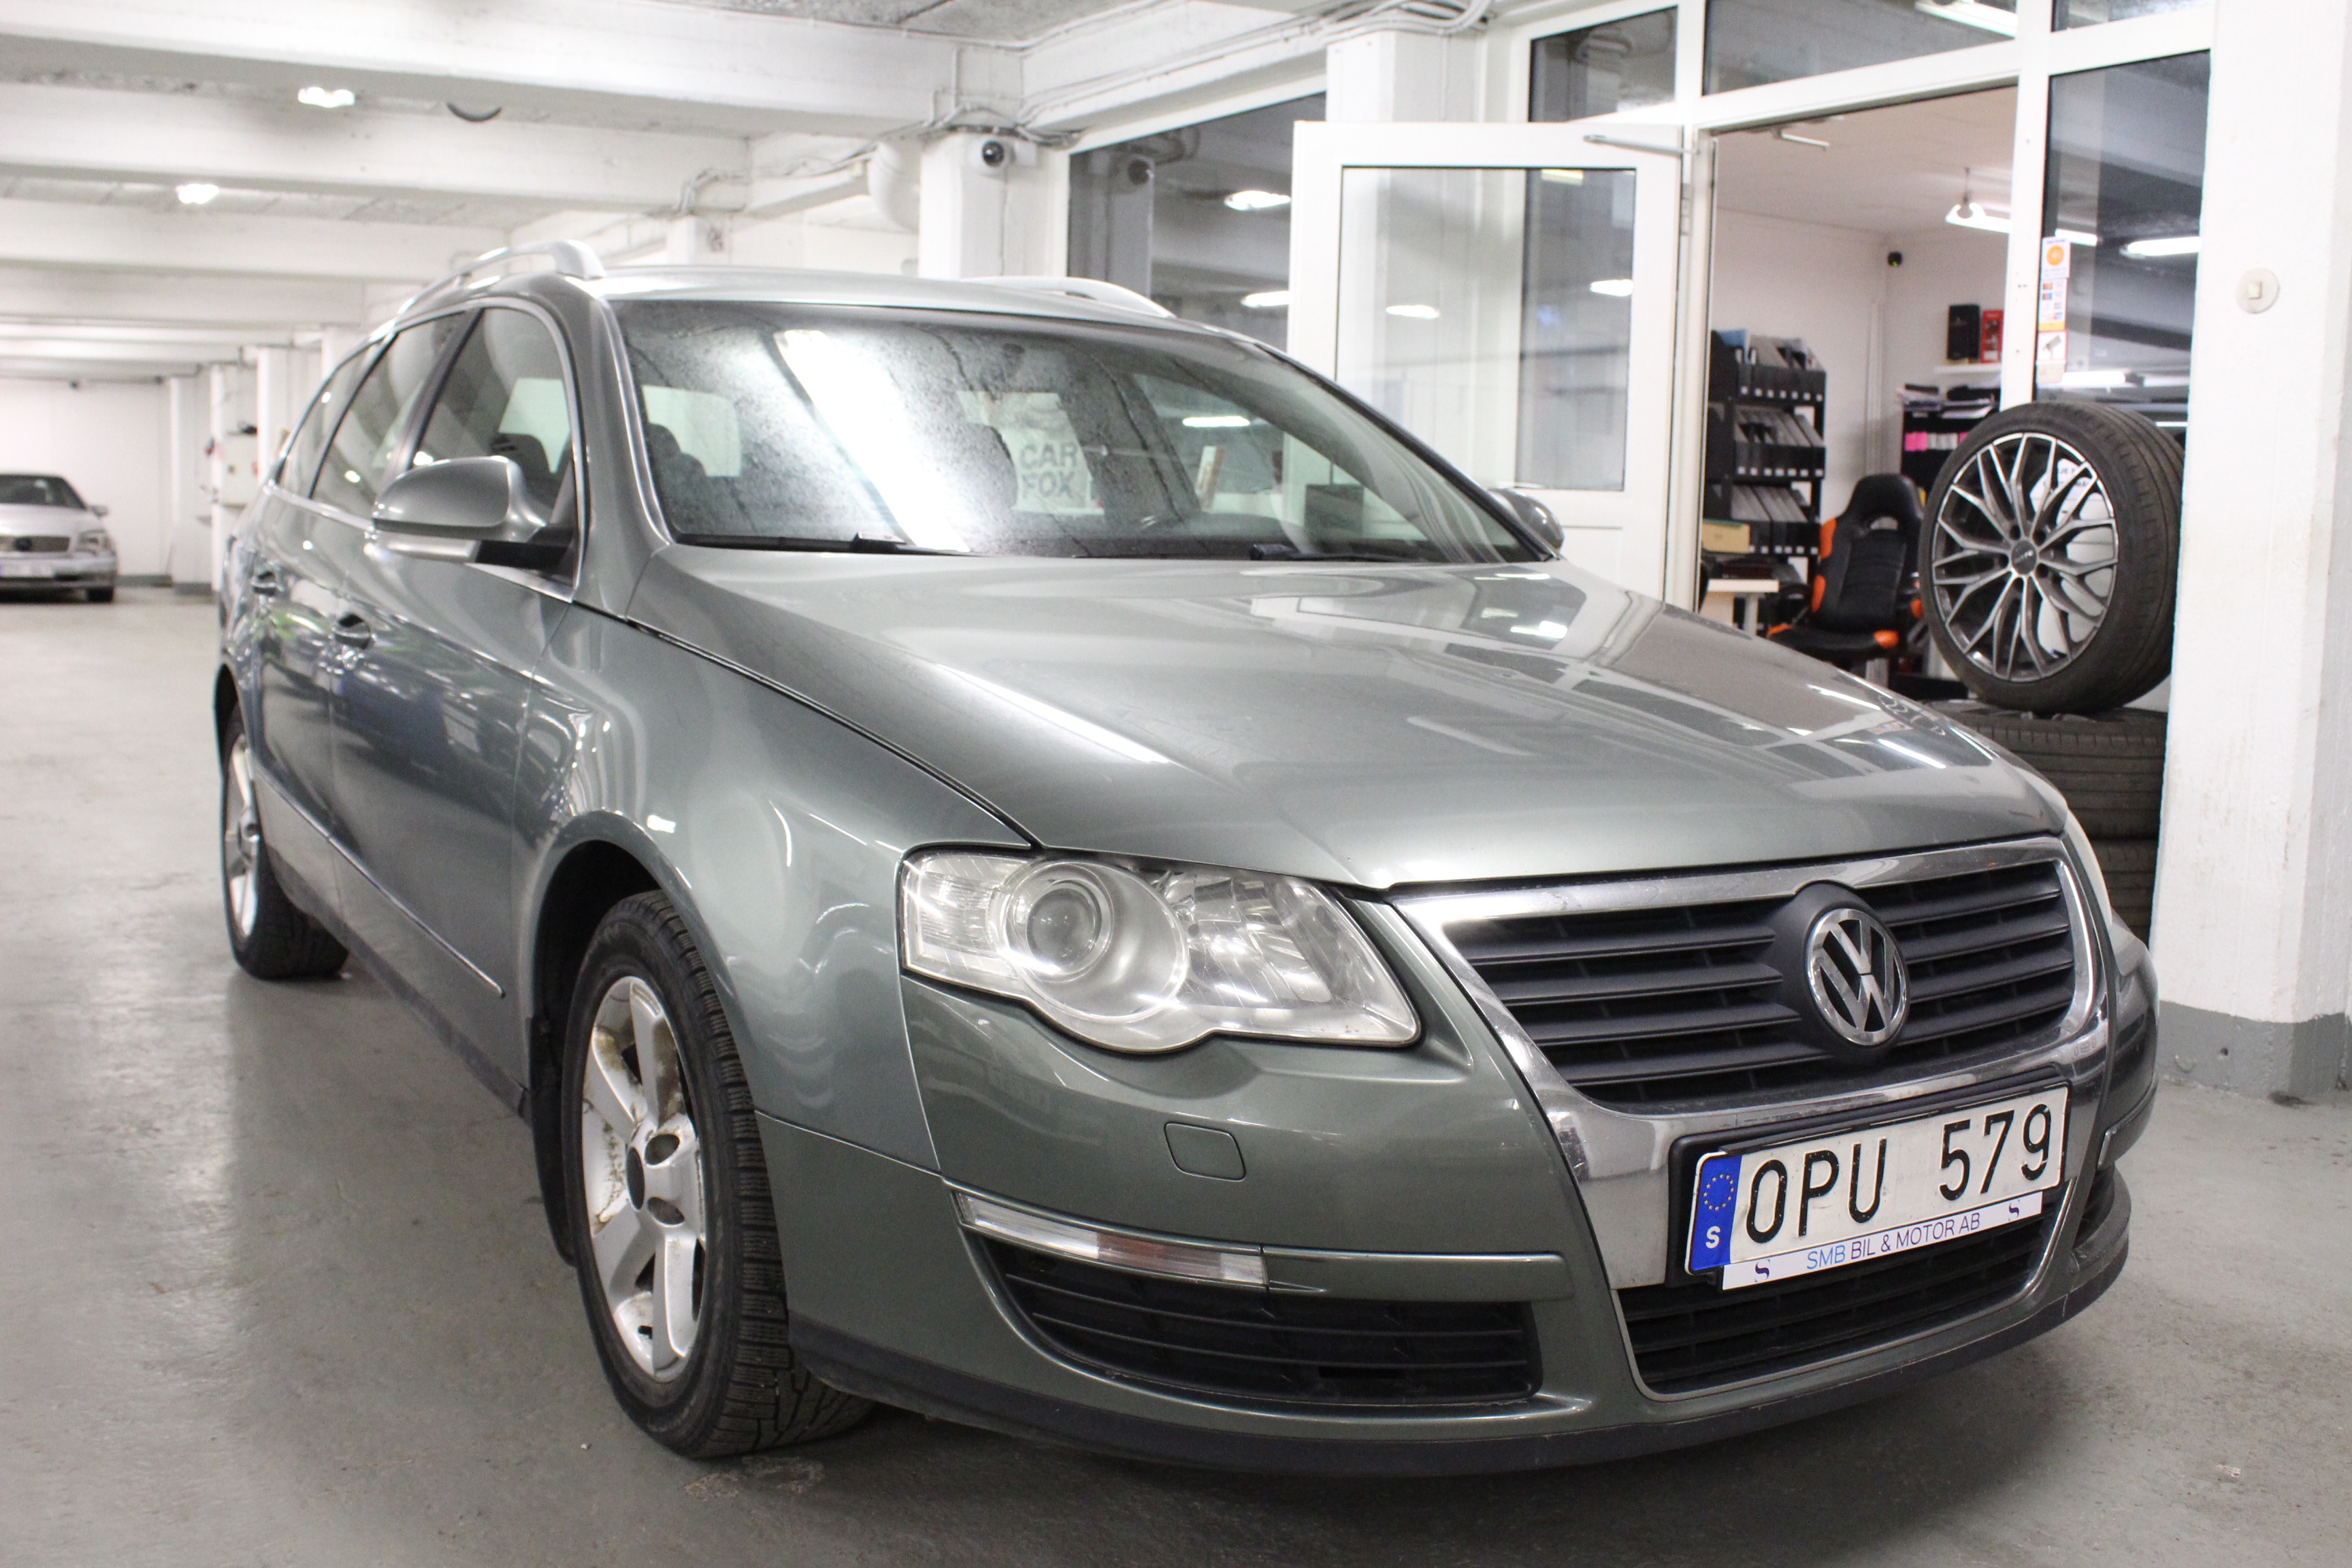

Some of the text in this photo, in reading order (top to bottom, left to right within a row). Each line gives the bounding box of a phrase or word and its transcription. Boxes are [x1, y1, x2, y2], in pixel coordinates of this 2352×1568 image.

[1019, 441, 1078, 469] CAR
[1022, 471, 1075, 499] FOX
[1807, 908, 1907, 1045] VW
[1746, 1103, 2052, 1244] OPU 579
[1705, 1225, 1720, 1249] S
[1806, 1212, 1980, 1270] SMB BIL & MOTOR AB
